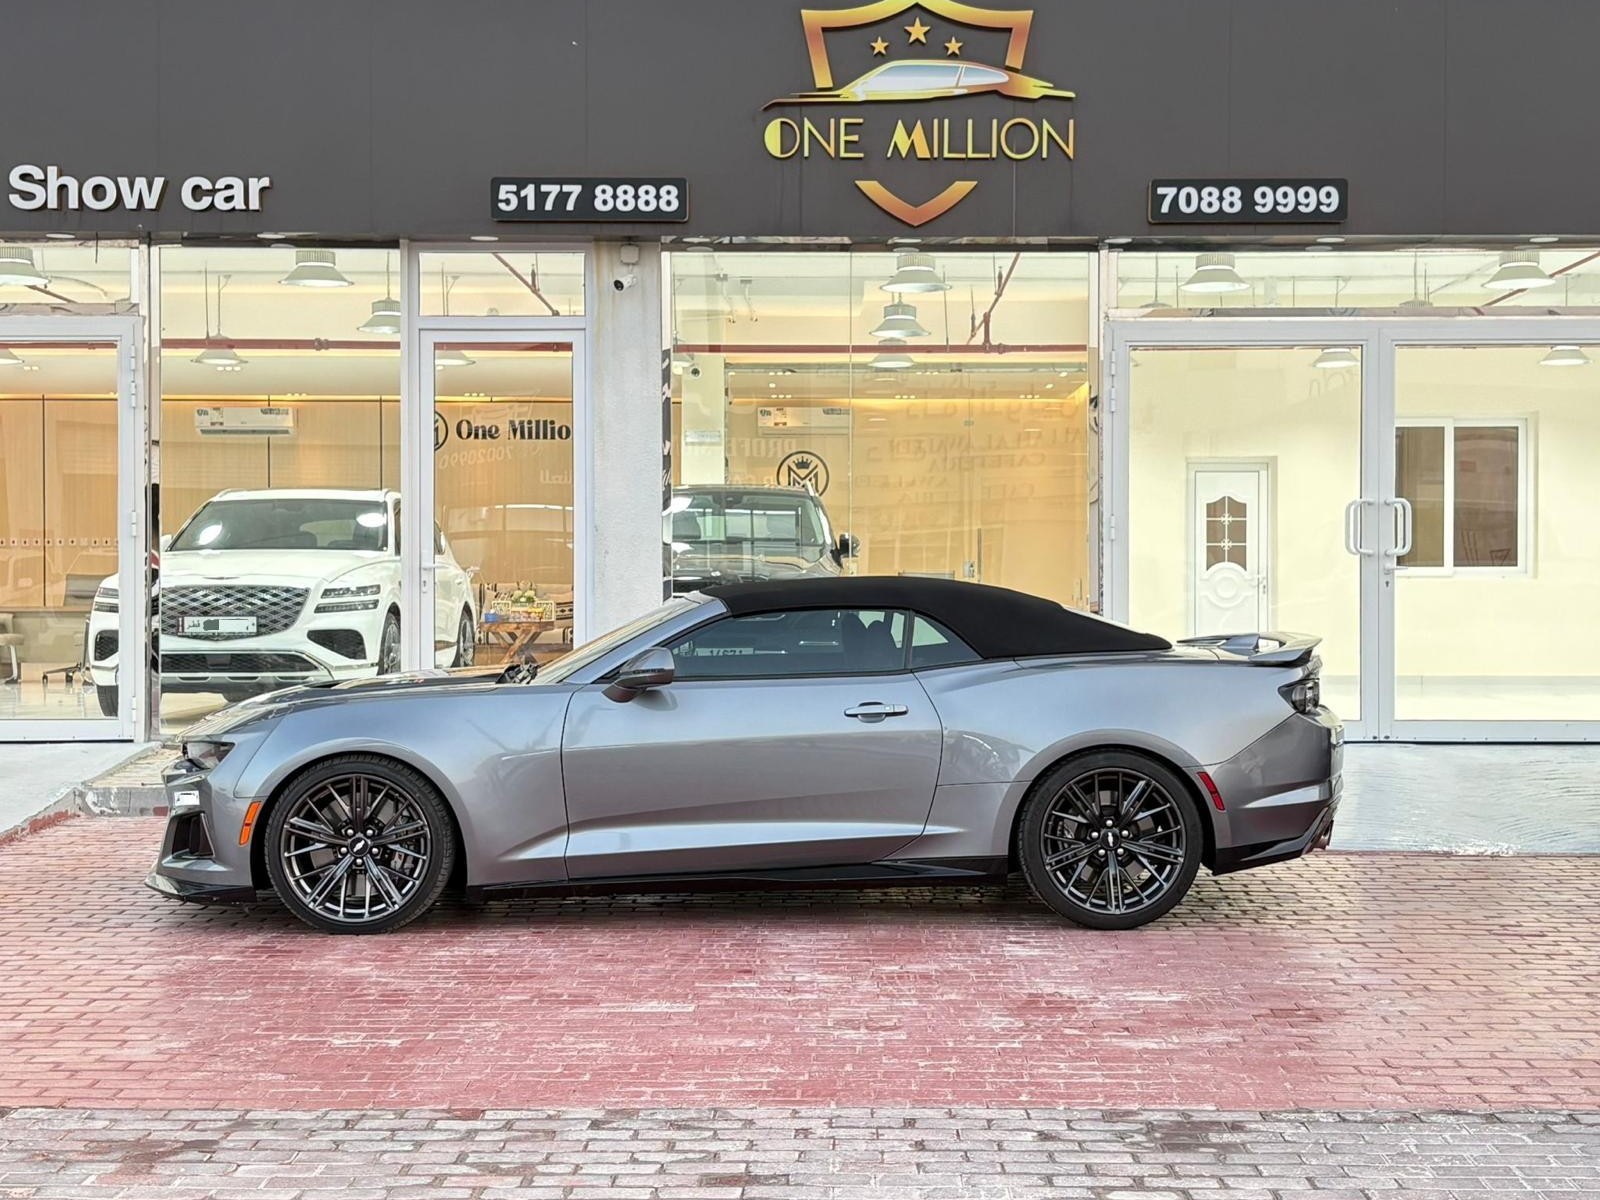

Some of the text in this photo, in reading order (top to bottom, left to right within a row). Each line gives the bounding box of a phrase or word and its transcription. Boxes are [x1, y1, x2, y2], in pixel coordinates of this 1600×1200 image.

[764, 117, 1075, 160] ONE MILLION
[8, 164, 270, 211] Show car
[497, 184, 679, 212] 5177 8888
[1156, 187, 1339, 213] 7088 9999
[456, 418, 571, 441] One Millio
